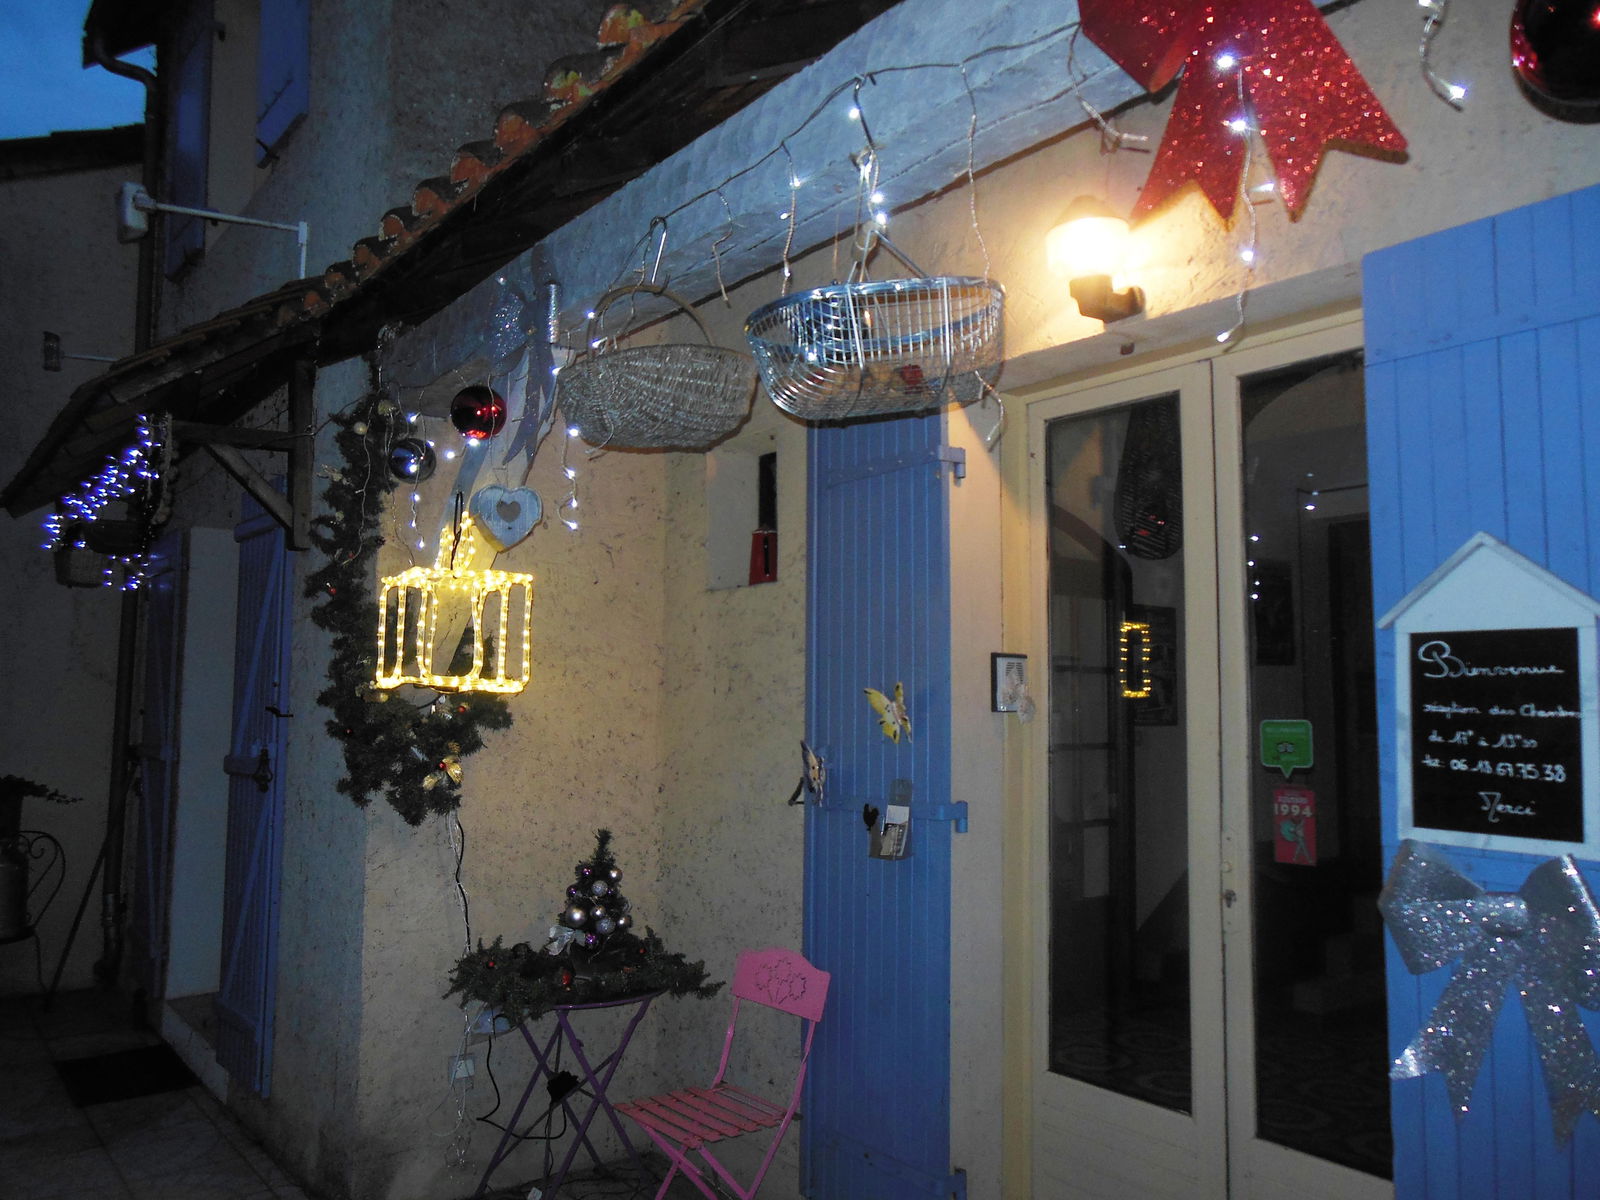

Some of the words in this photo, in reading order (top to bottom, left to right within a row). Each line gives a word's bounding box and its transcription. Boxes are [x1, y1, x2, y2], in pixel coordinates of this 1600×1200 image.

[1418, 640, 1565, 678] Bienvenue
[1274, 802, 1312, 817] 1994
[1477, 791, 1536, 823] Merci
